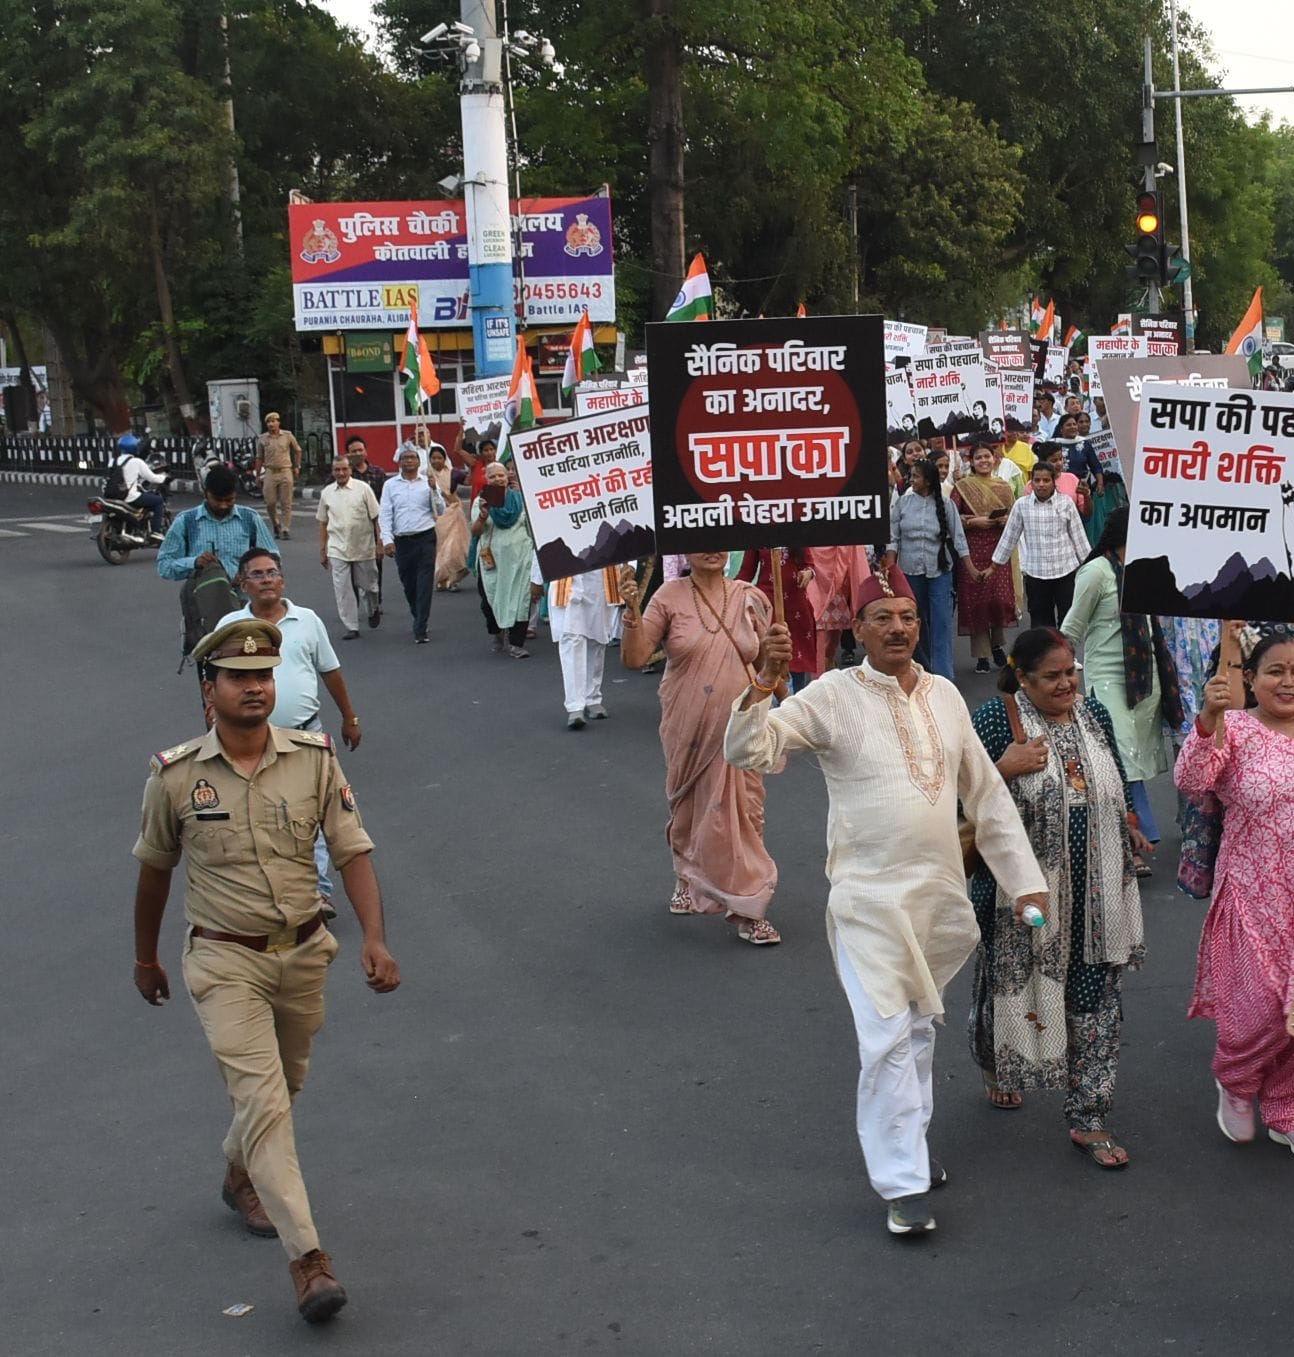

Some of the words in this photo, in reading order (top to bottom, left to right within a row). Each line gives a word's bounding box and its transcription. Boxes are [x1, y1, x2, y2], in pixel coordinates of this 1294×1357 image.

[338, 212, 400, 243] पुलिस
[406, 211, 460, 235] चौकी
[373, 241, 451, 261] कोतवाली
[303, 289, 381, 310] BATTLE
[385, 288, 417, 307] IAS
[528, 304, 565, 315] Battle
[569, 303, 588, 314] IAS
[303, 317, 338, 326] PURANIA
[339, 314, 385, 325] CHAURAHA,
[486, 319, 494, 328] IF
[1096, 338, 1128, 350] महापौर
[1130, 338, 1140, 349] के
[684, 341, 763, 377] सैनिक
[765, 340, 847, 374] परिवार
[914, 358, 934, 372] सपा
[935, 353, 949, 369] की
[950, 354, 983, 367] पहचान,
[461, 383, 484, 395] महिला
[915, 373, 938, 389] नारी
[940, 370, 961, 386] शक्ति
[1003, 374, 1031, 384] आरक्षण
[585, 391, 629, 410] महापौर
[631, 389, 643, 405] के
[703, 389, 737, 415] का
[742, 386, 831, 415] अनादर,
[918, 396, 930, 407] का
[931, 393, 960, 405] अपमान
[1149, 397, 1211, 432] सपा
[1215, 393, 1256, 435] की
[519, 431, 580, 462] महिला
[584, 415, 649, 446] आरक्षण
[538, 463, 556, 479] पर
[557, 453, 590, 474] घटिया
[592, 440, 646, 469] राजनीति,
[688, 433, 782, 484] सपा
[786, 427, 850, 479] का
[1142, 441, 1211, 481] नारी
[1217, 445, 1287, 486] शक्ति
[535, 473, 602, 510] सपाइयों
[603, 468, 628, 494] की
[569, 501, 608, 529] पुरानी
[609, 495, 639, 516] निति
[663, 494, 735, 529] असली
[737, 493, 795, 525] चेहरा
[1139, 500, 1174, 527] का
[1178, 503, 1271, 533] अपमान
